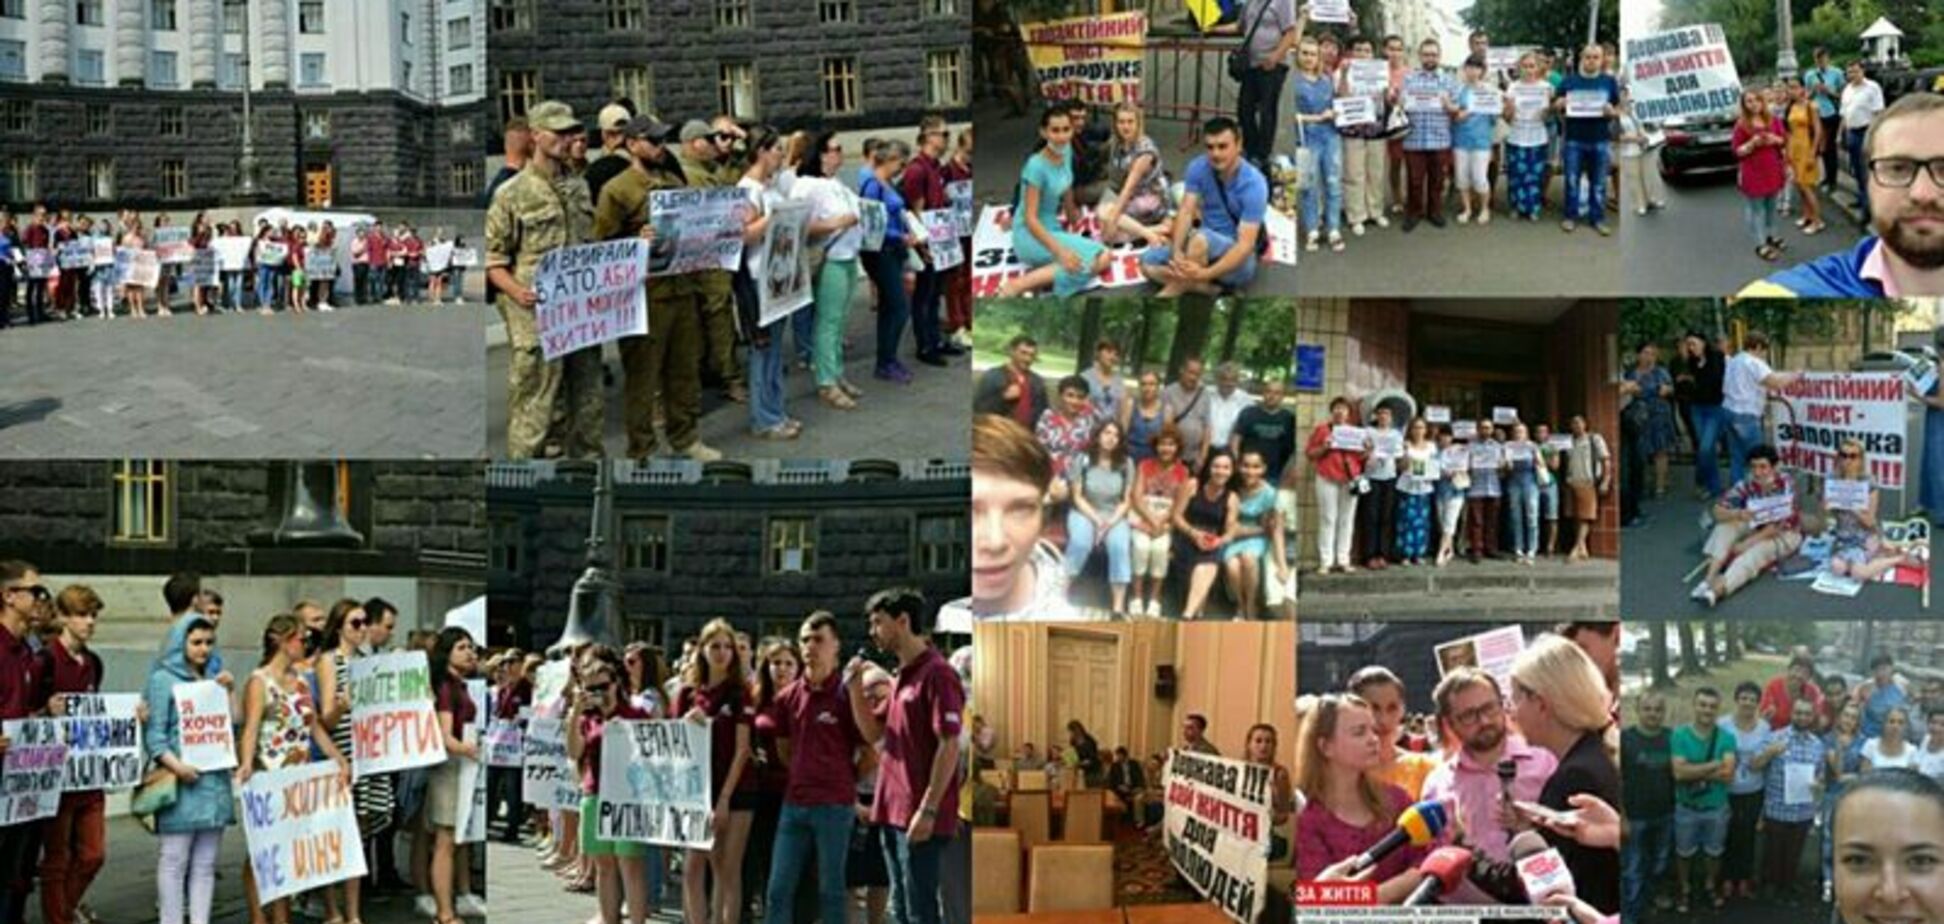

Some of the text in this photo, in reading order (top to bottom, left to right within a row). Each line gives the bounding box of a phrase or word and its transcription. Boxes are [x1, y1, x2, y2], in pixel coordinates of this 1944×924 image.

[1665, 48, 1726, 72] ЖИТТЯ
[603, 263, 637, 288] АБИ
[545, 320, 607, 354] ЖИТИ
[1807, 403, 1852, 424] ЛИСТ
[181, 700, 194, 715] Я
[182, 714, 227, 730] ХОЧУ
[1195, 790, 1259, 842] ЖИТТЯ
[293, 831, 343, 880] ЦІНУ
